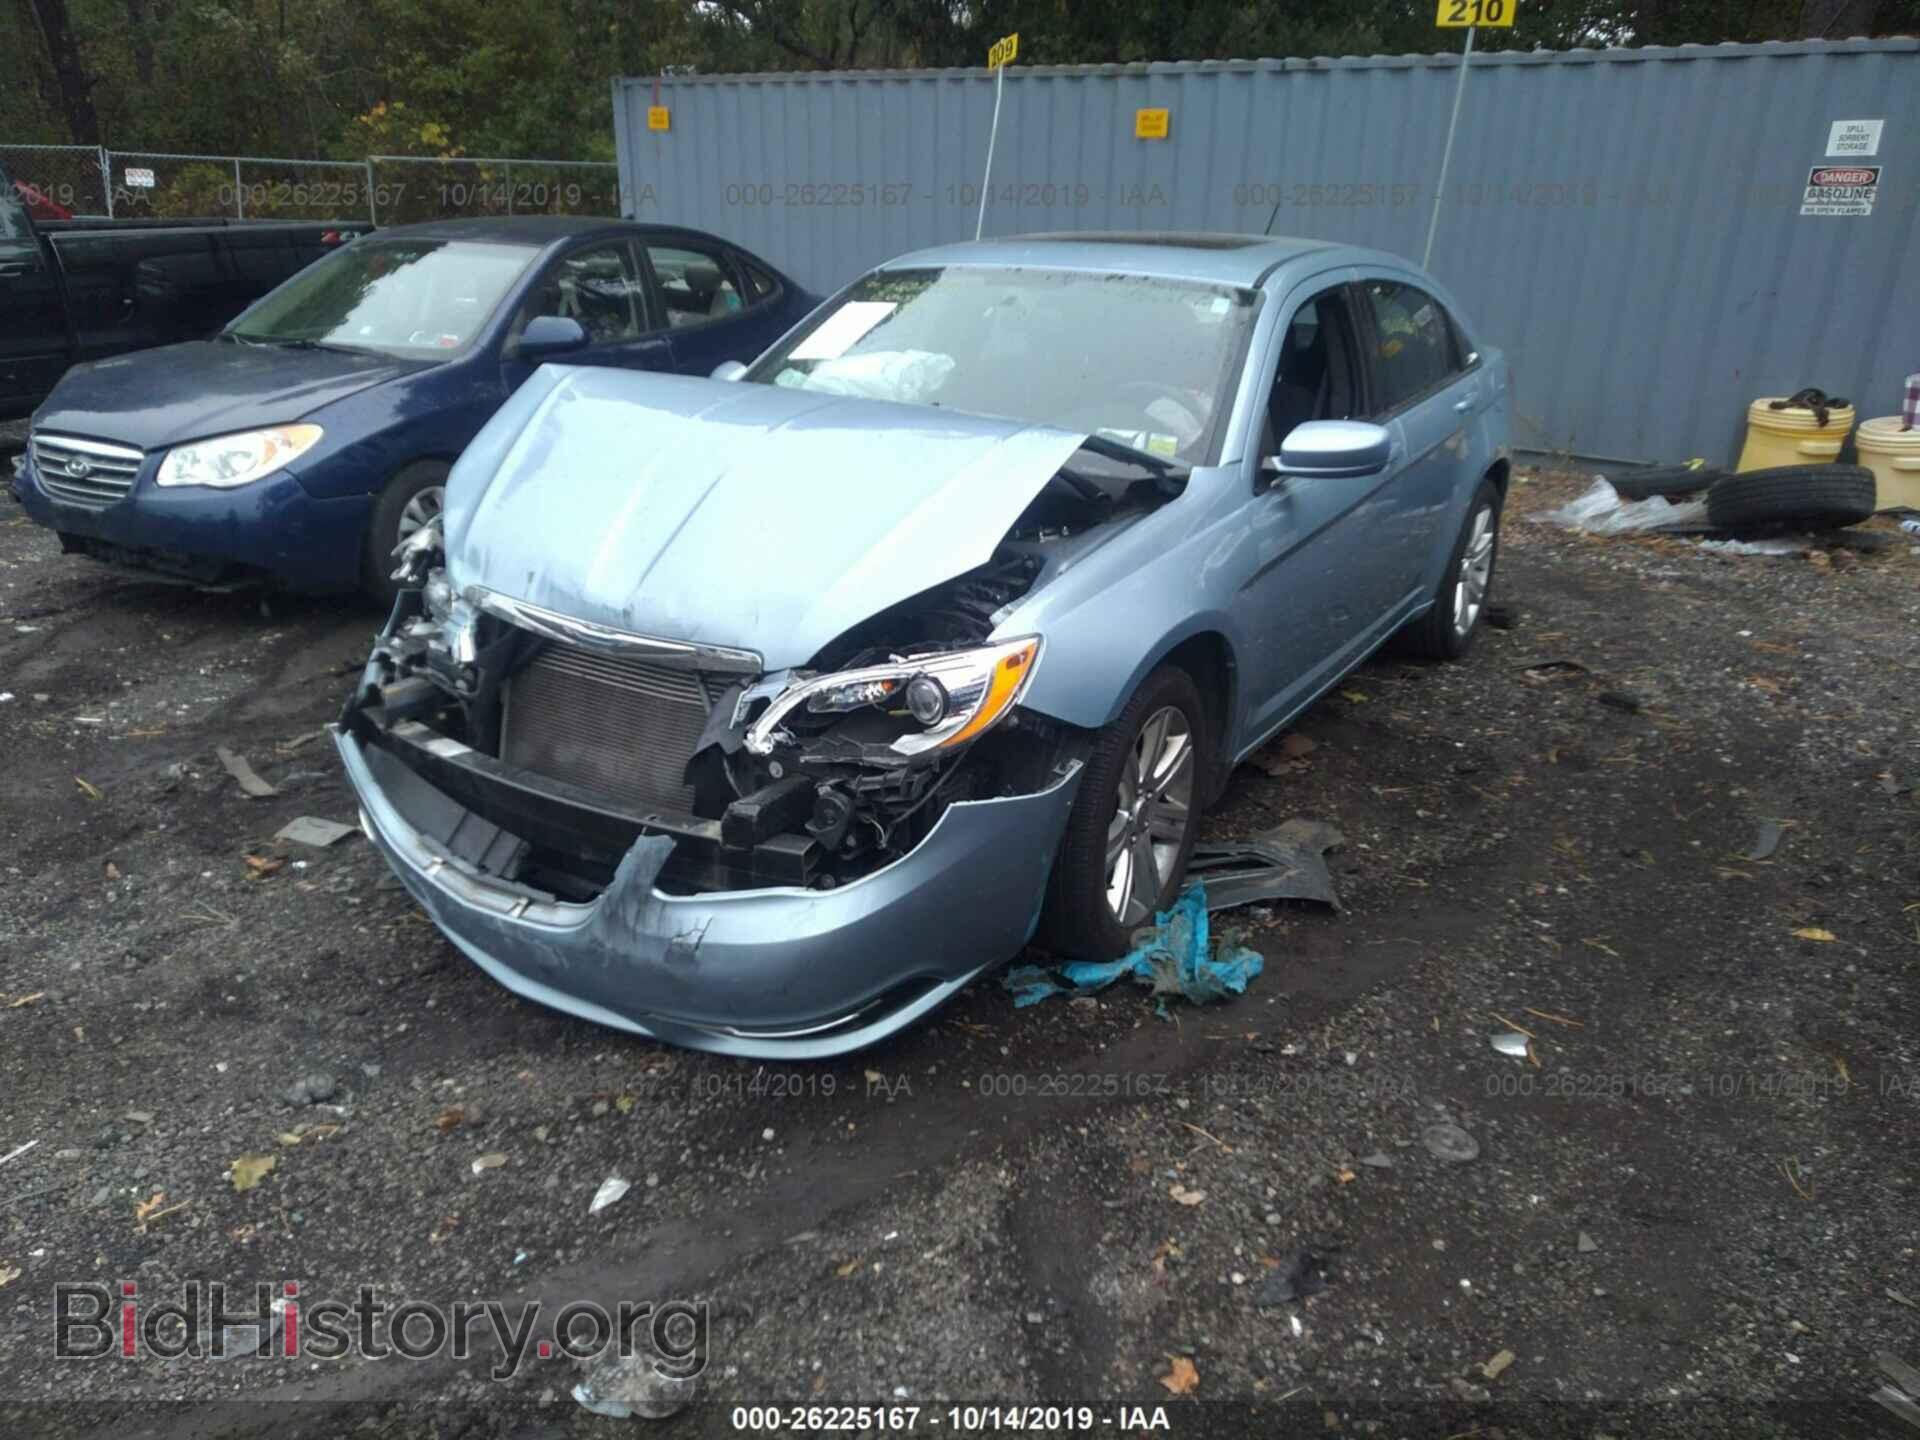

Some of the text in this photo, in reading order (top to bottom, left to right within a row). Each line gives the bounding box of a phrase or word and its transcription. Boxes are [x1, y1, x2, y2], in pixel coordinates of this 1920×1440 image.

[1448, 0, 1504, 21] 210
[1846, 125, 1864, 133] SPILL
[1823, 172, 1868, 183] DANGER
[1807, 187, 1874, 200] GASOLINE
